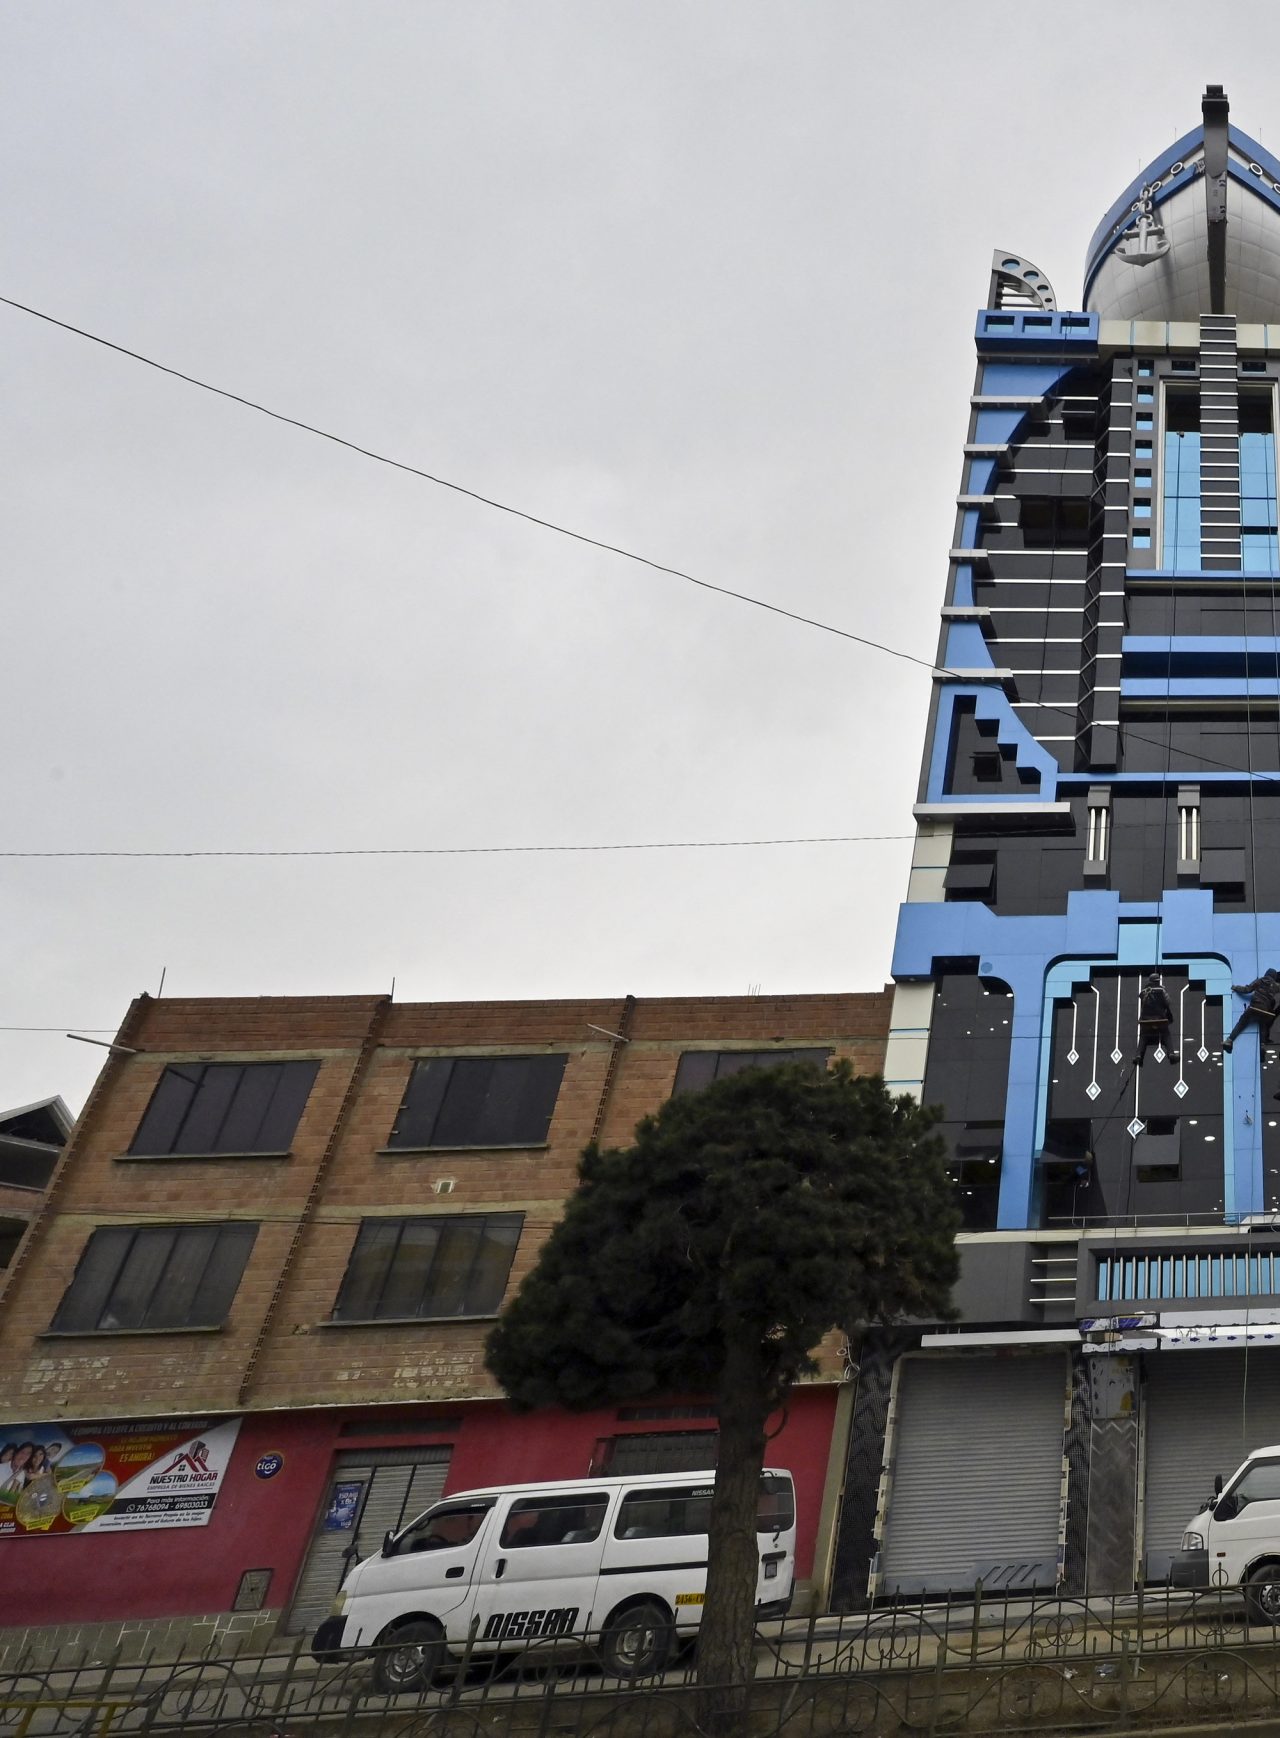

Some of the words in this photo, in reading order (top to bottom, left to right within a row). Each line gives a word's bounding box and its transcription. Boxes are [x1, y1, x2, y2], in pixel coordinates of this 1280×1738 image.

[150, 1474, 188, 1484] NUESTRO
[189, 1472, 218, 1482] HOGAR
[483, 1608, 579, 1639] NISSAN
